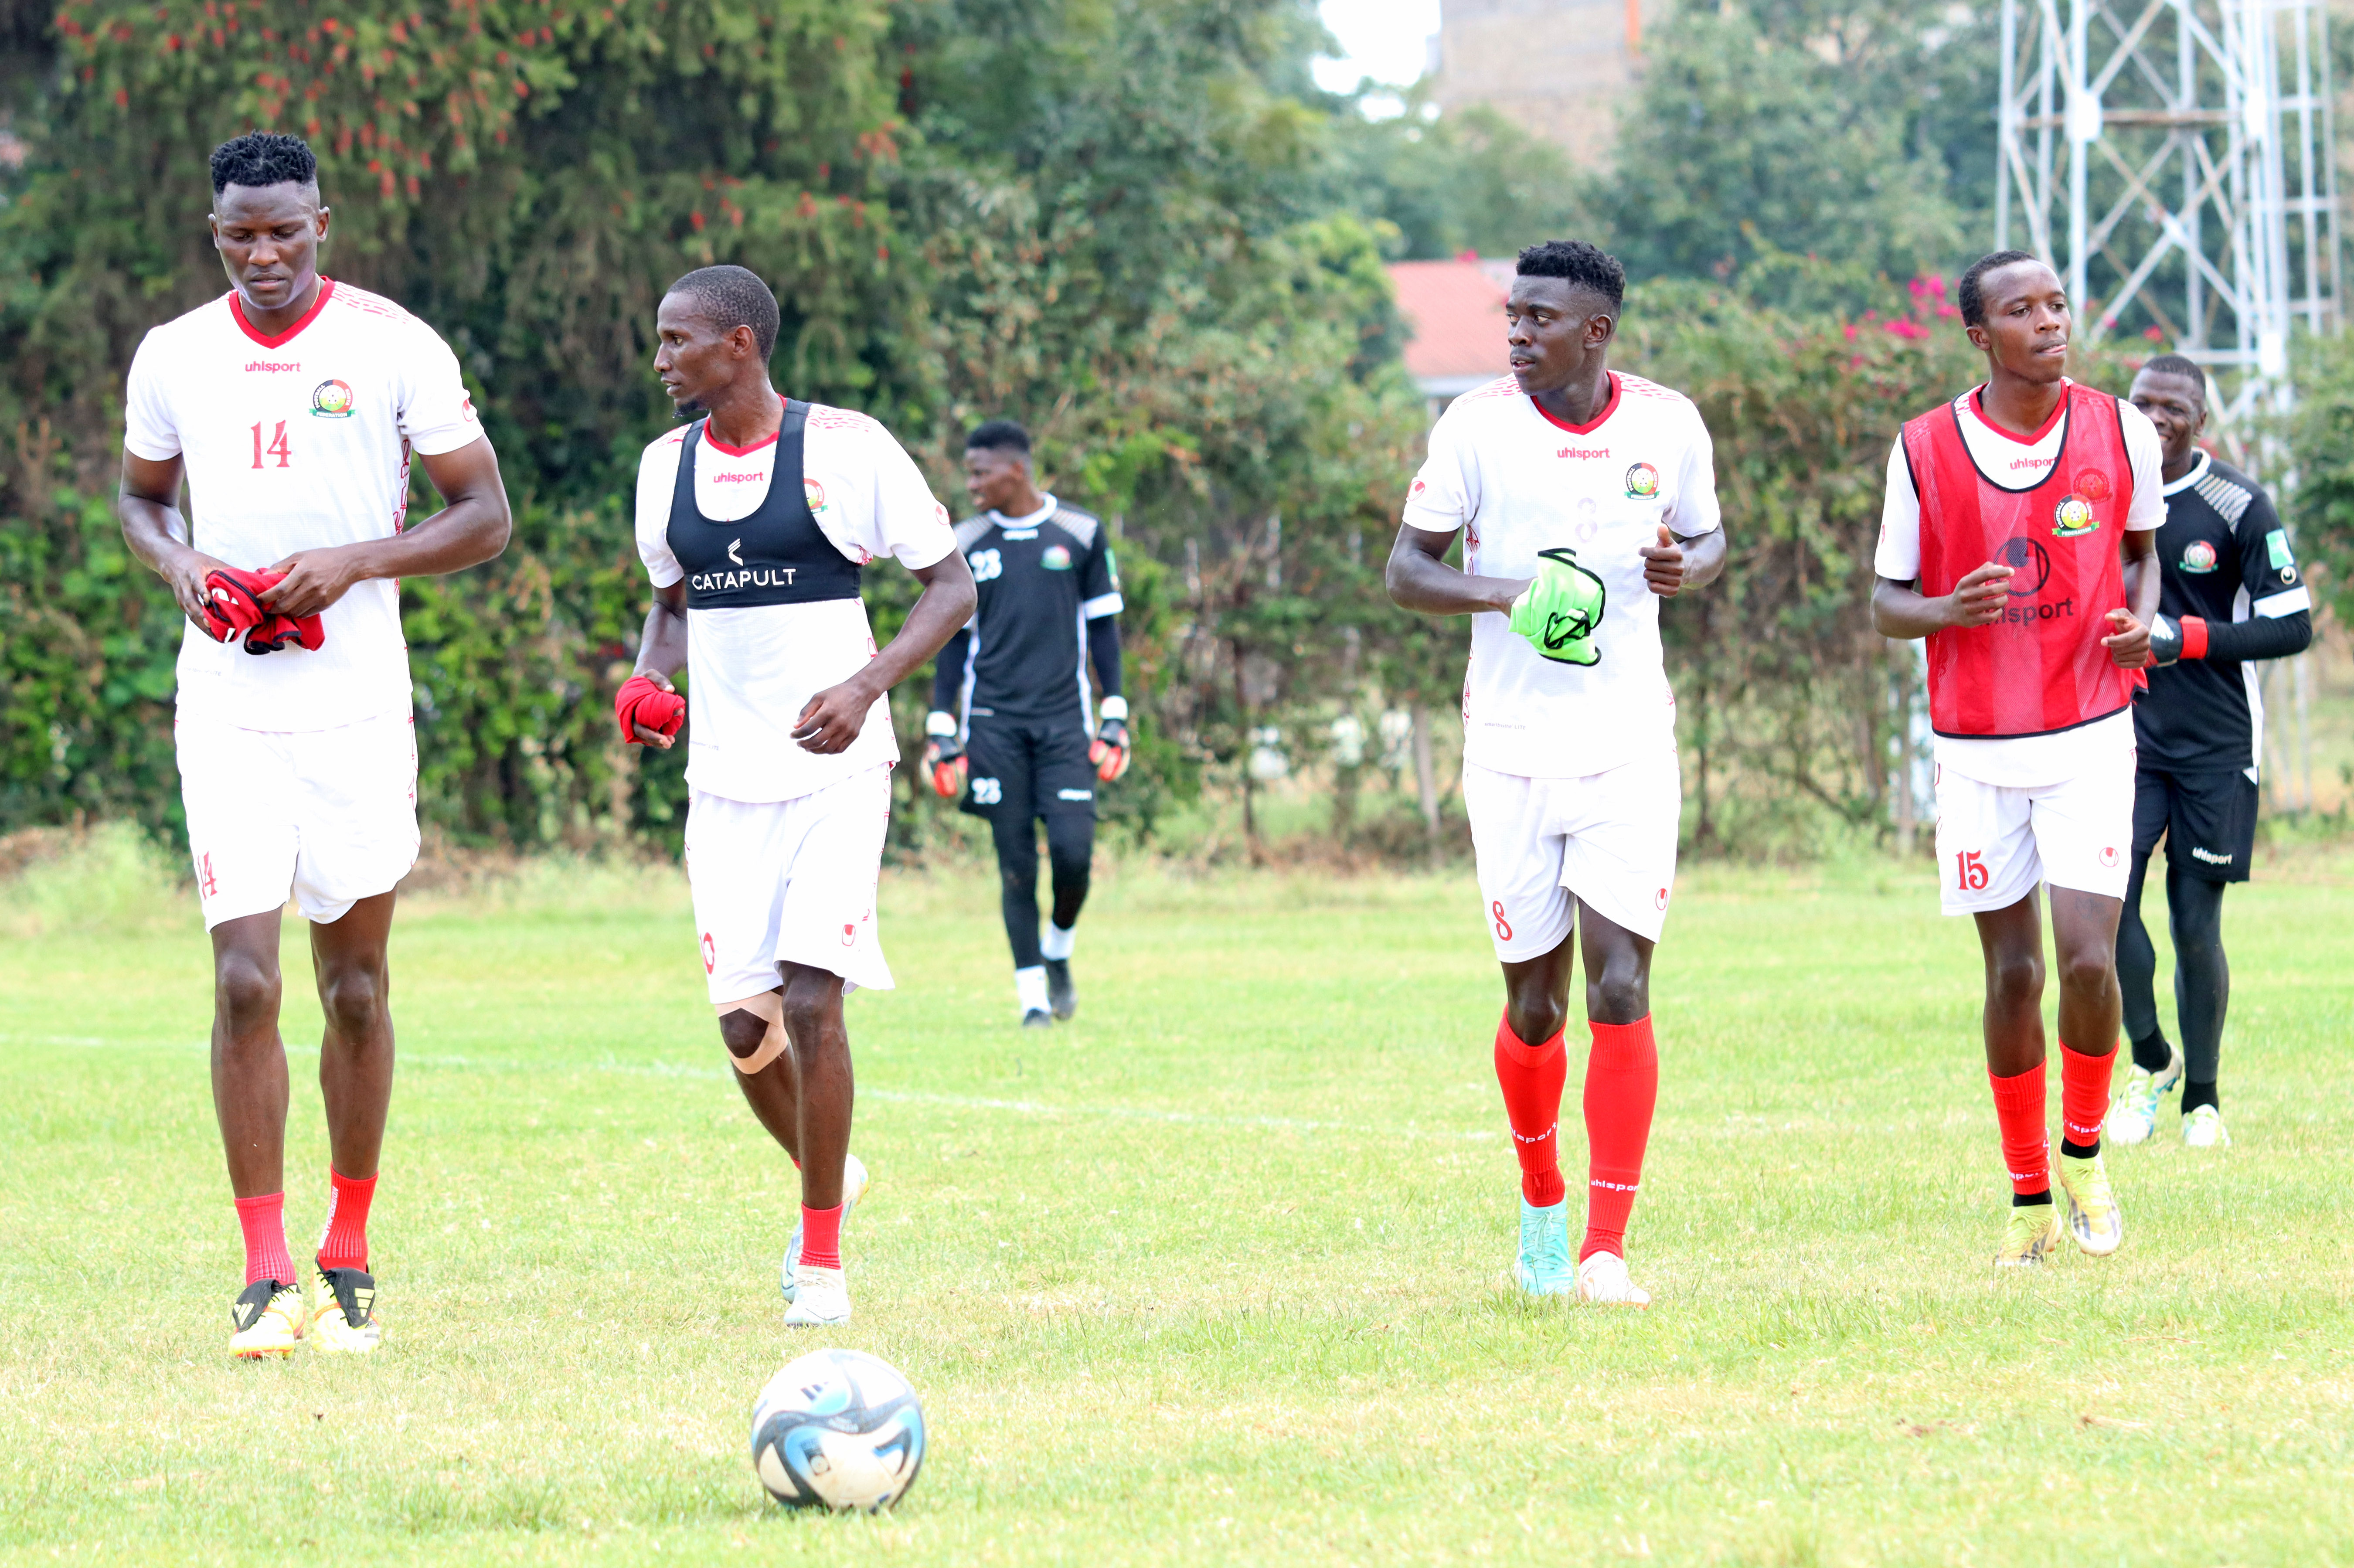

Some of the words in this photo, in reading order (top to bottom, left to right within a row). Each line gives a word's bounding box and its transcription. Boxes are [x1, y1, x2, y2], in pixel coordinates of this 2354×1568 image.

[245, 361, 301, 374] uhlsport
[250, 419, 292, 469] 14
[1557, 447, 1610, 461] uhlsport
[714, 472, 763, 484] uhlsport
[1575, 497, 1598, 544] 8
[2056, 502, 2065, 528] FOOTBALL
[2061, 526, 2092, 536] FEDERATION
[969, 548, 1003, 582] 23
[692, 568, 796, 590] CATAPULT
[1986, 597, 2073, 626] lsport
[971, 777, 1002, 804] 23
[2192, 847, 2232, 865] uhlsport
[1956, 849, 1989, 890] 15
[1493, 901, 1512, 941] 8
[1509, 1122, 1556, 1143] hlsport
[1591, 1179, 1639, 1191] uhlspor
